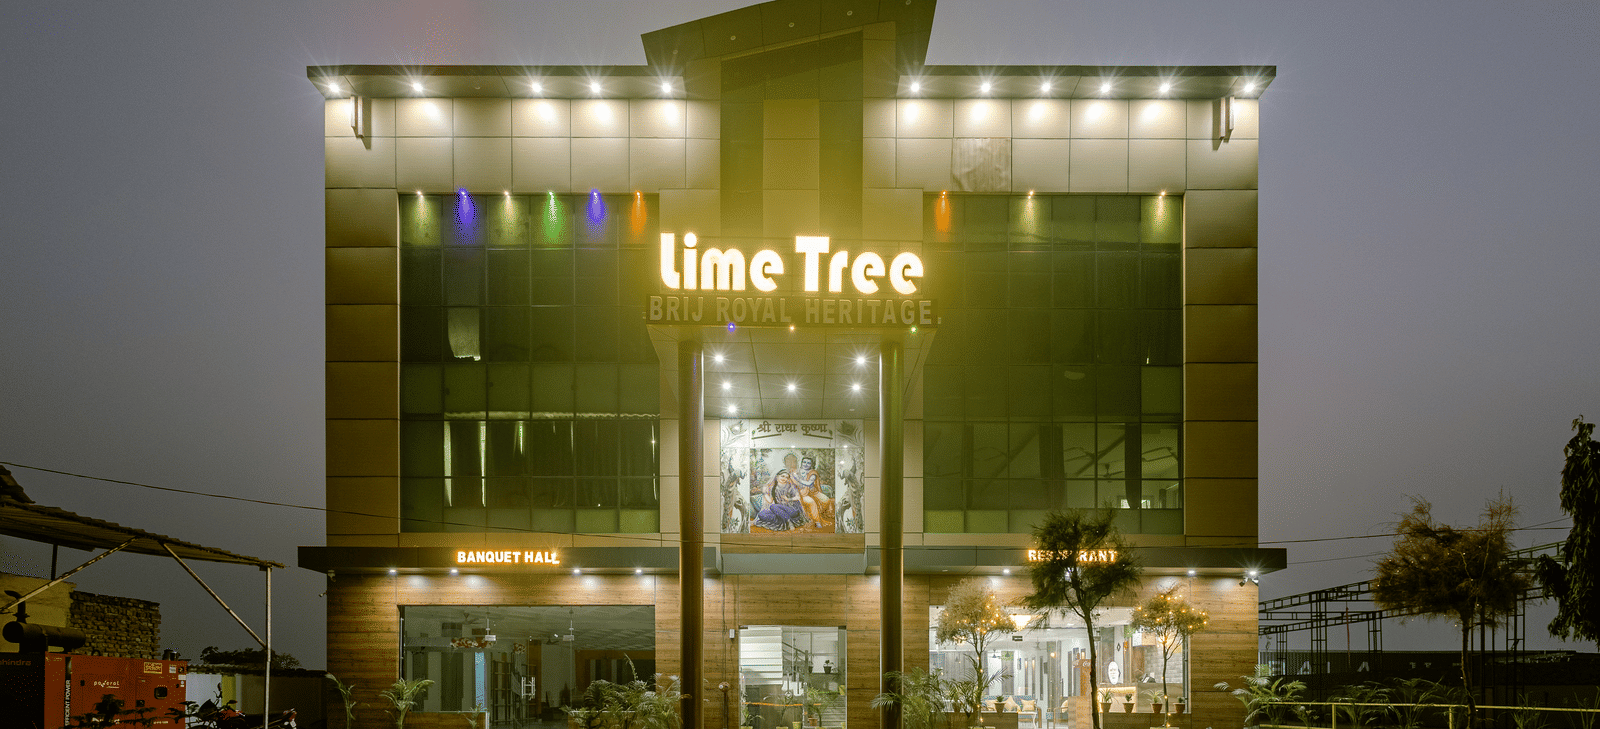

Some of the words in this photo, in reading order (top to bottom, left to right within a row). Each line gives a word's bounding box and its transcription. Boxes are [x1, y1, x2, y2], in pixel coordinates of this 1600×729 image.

[660, 232, 784, 292] Lime
[795, 235, 924, 294] Tree
[649, 295, 704, 322] BRIJ
[716, 296, 792, 323] ROYAL
[757, 420, 772, 433] श्री
[774, 423, 798, 433] राधा
[800, 423, 828, 435] कृष्णा
[457, 551, 521, 563] BANQUET
[524, 551, 560, 564] HALL
[1028, 549, 1118, 562] RESRANT
[0, 658, 32, 666] hindra
